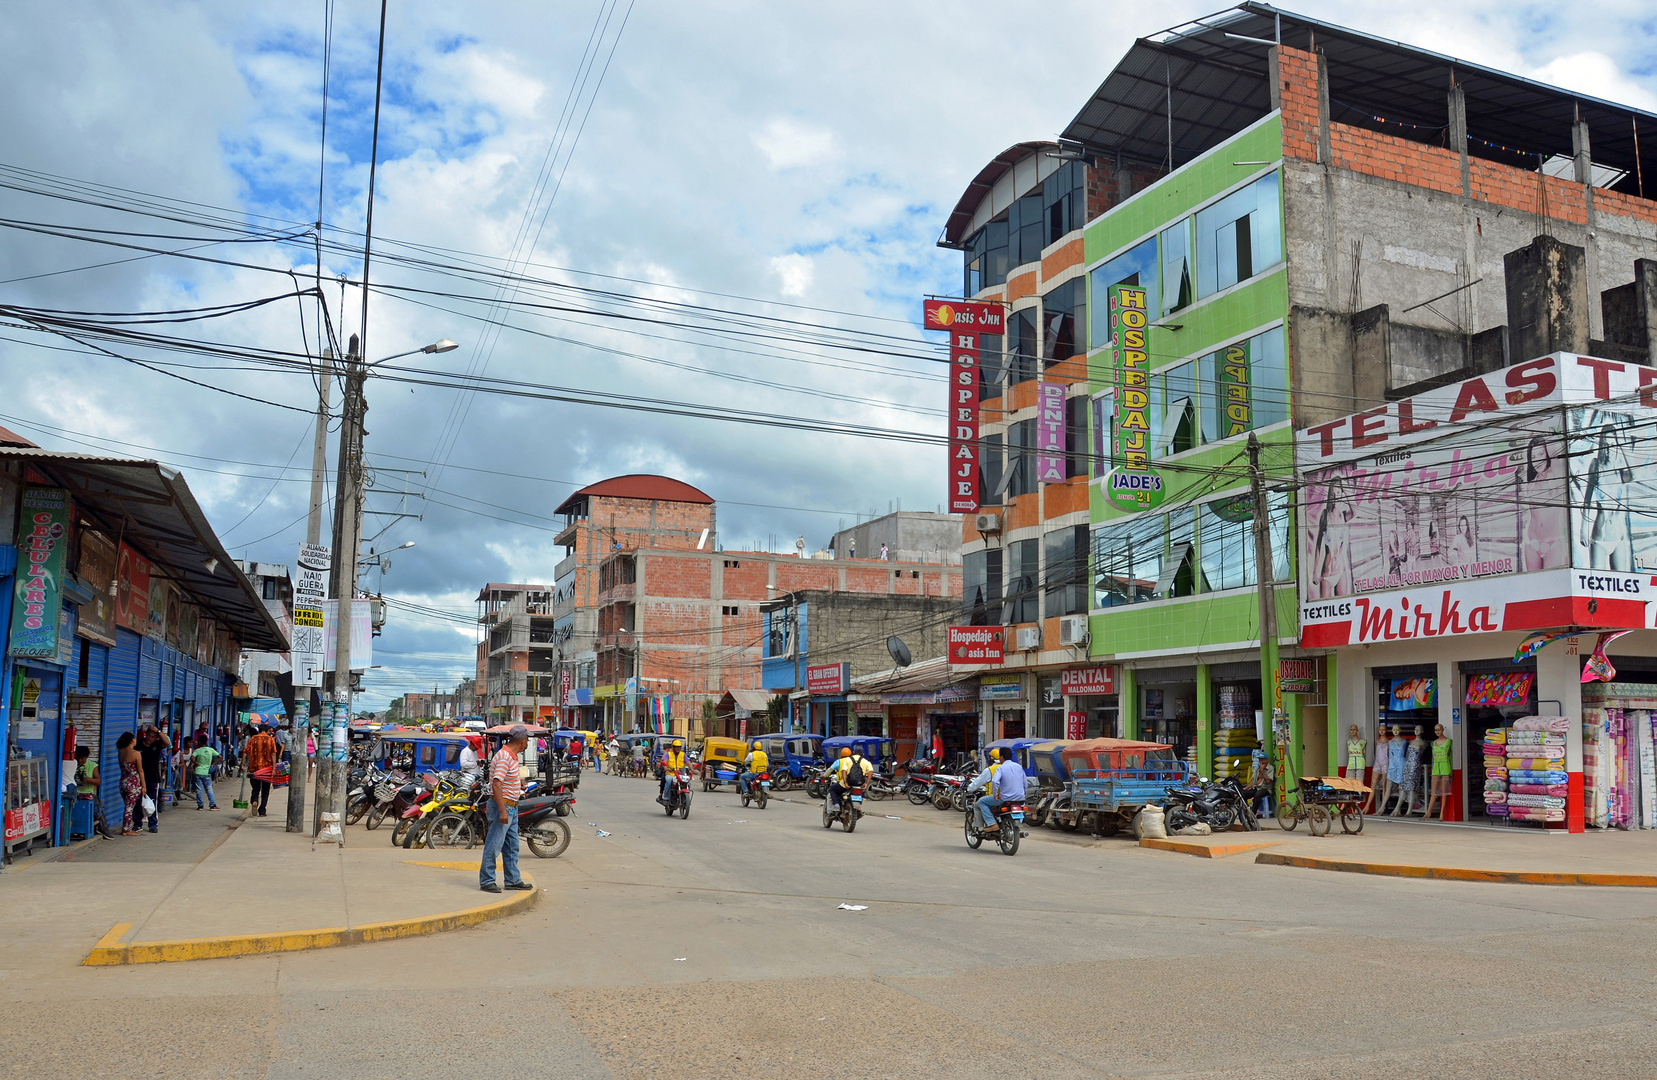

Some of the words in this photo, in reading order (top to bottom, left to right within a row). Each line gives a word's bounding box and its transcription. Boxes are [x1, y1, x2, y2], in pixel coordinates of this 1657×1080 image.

[978, 308, 1000, 325] Inn
[1111, 296, 1119, 454] HOSPEDAJE
[1118, 288, 1150, 471] HOSPEDAJE
[1308, 357, 1556, 457] TELAS
[956, 335, 974, 496] HOSPEDAJE
[1044, 386, 1063, 480] DENTISTA
[1375, 451, 1412, 467] Textiles
[1112, 473, 1162, 491] JADE'S
[27, 490, 63, 499] SERVICIO
[1136, 492, 1151, 502] 24
[306, 544, 328, 553] ALIANZA
[304, 557, 326, 566] NACIONAL
[24, 512, 52, 629] CELULARES
[1355, 576, 1384, 592] TELAS
[1387, 574, 1400, 588] AL
[1401, 571, 1421, 586] POR
[1424, 566, 1460, 583] MAYOR
[1460, 565, 1470, 579] Y
[1472, 558, 1512, 576] MENOR
[1579, 575, 1640, 593] TEXTILES
[1304, 603, 1351, 620] TEXTILES
[1355, 590, 1498, 642] Mirka
[950, 629, 992, 645] Hospedaje
[13, 648, 52, 656] RELOJES
[986, 648, 1000, 658] Inn
[307, 668, 312, 680] 1
[809, 671, 813, 680] EL
[1062, 668, 1112, 684] DENTAL
[1280, 660, 1312, 679] OSPEDAJE
[1068, 685, 1105, 694] MALDONADO
